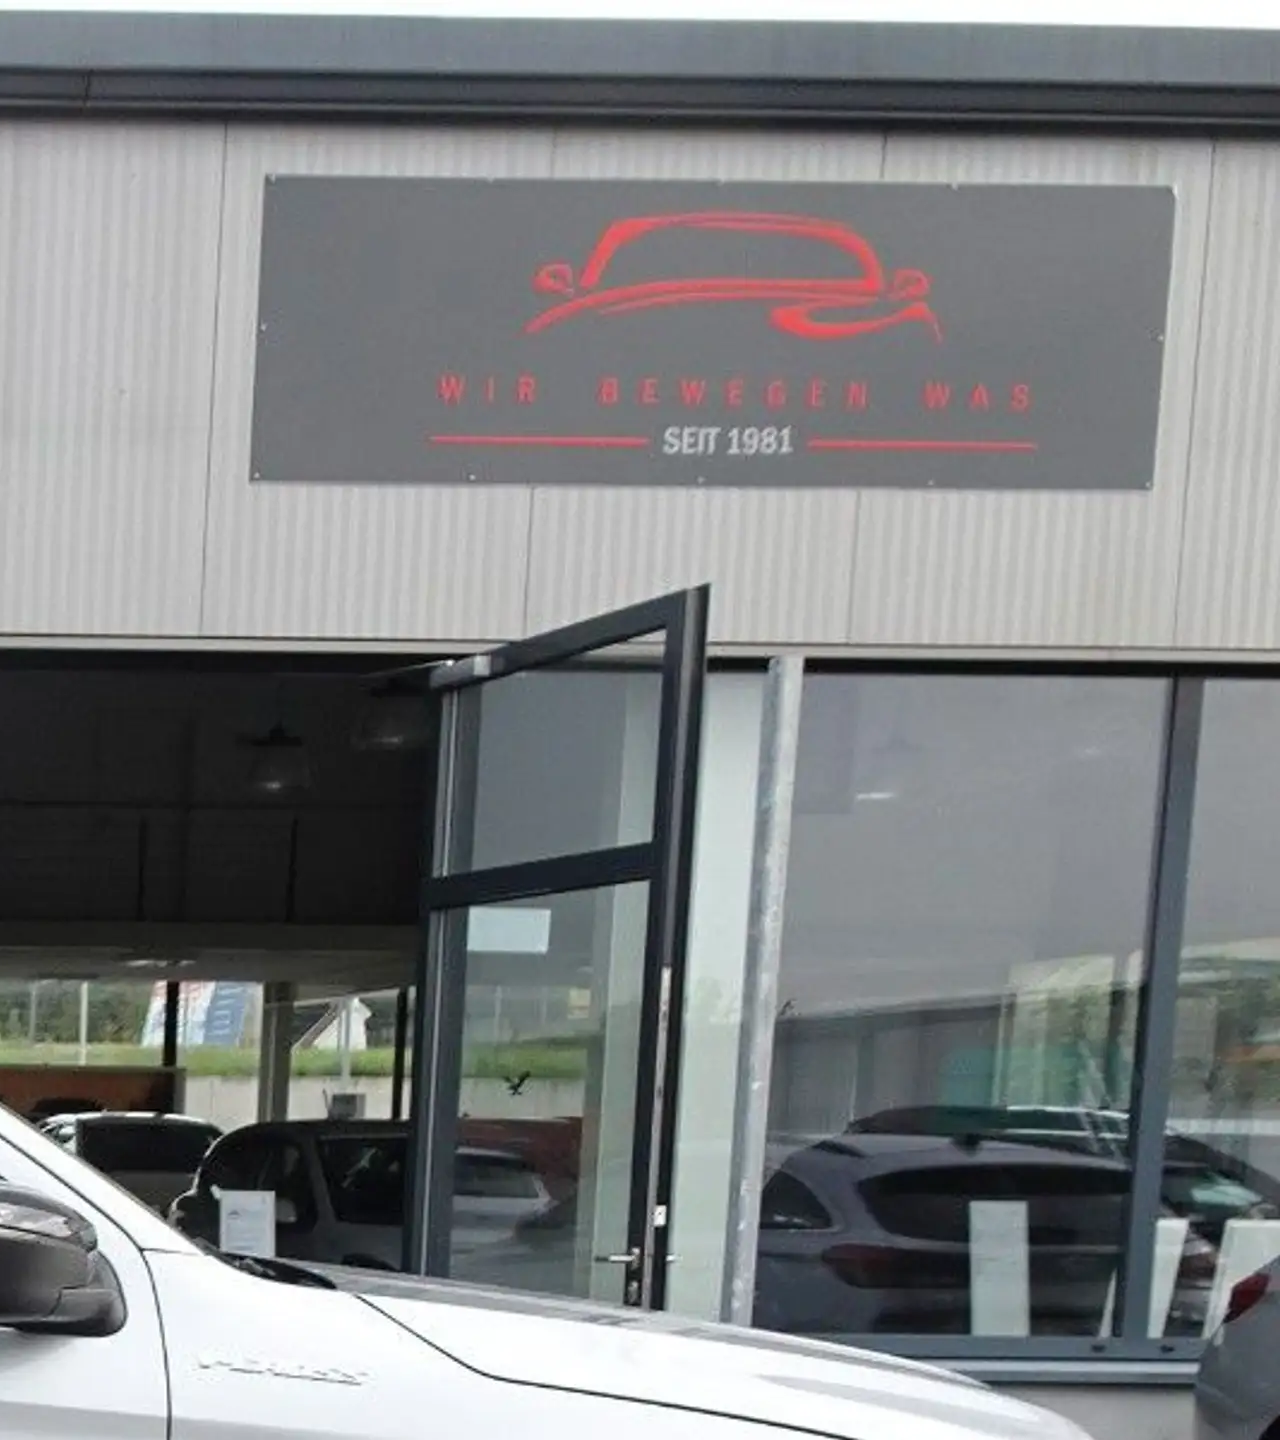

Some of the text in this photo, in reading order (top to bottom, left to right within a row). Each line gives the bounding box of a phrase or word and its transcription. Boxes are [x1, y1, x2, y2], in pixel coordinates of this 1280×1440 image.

[437, 373, 1032, 411] WIR BEWEGEN WAS
[661, 425, 794, 456] SEIT 1981
